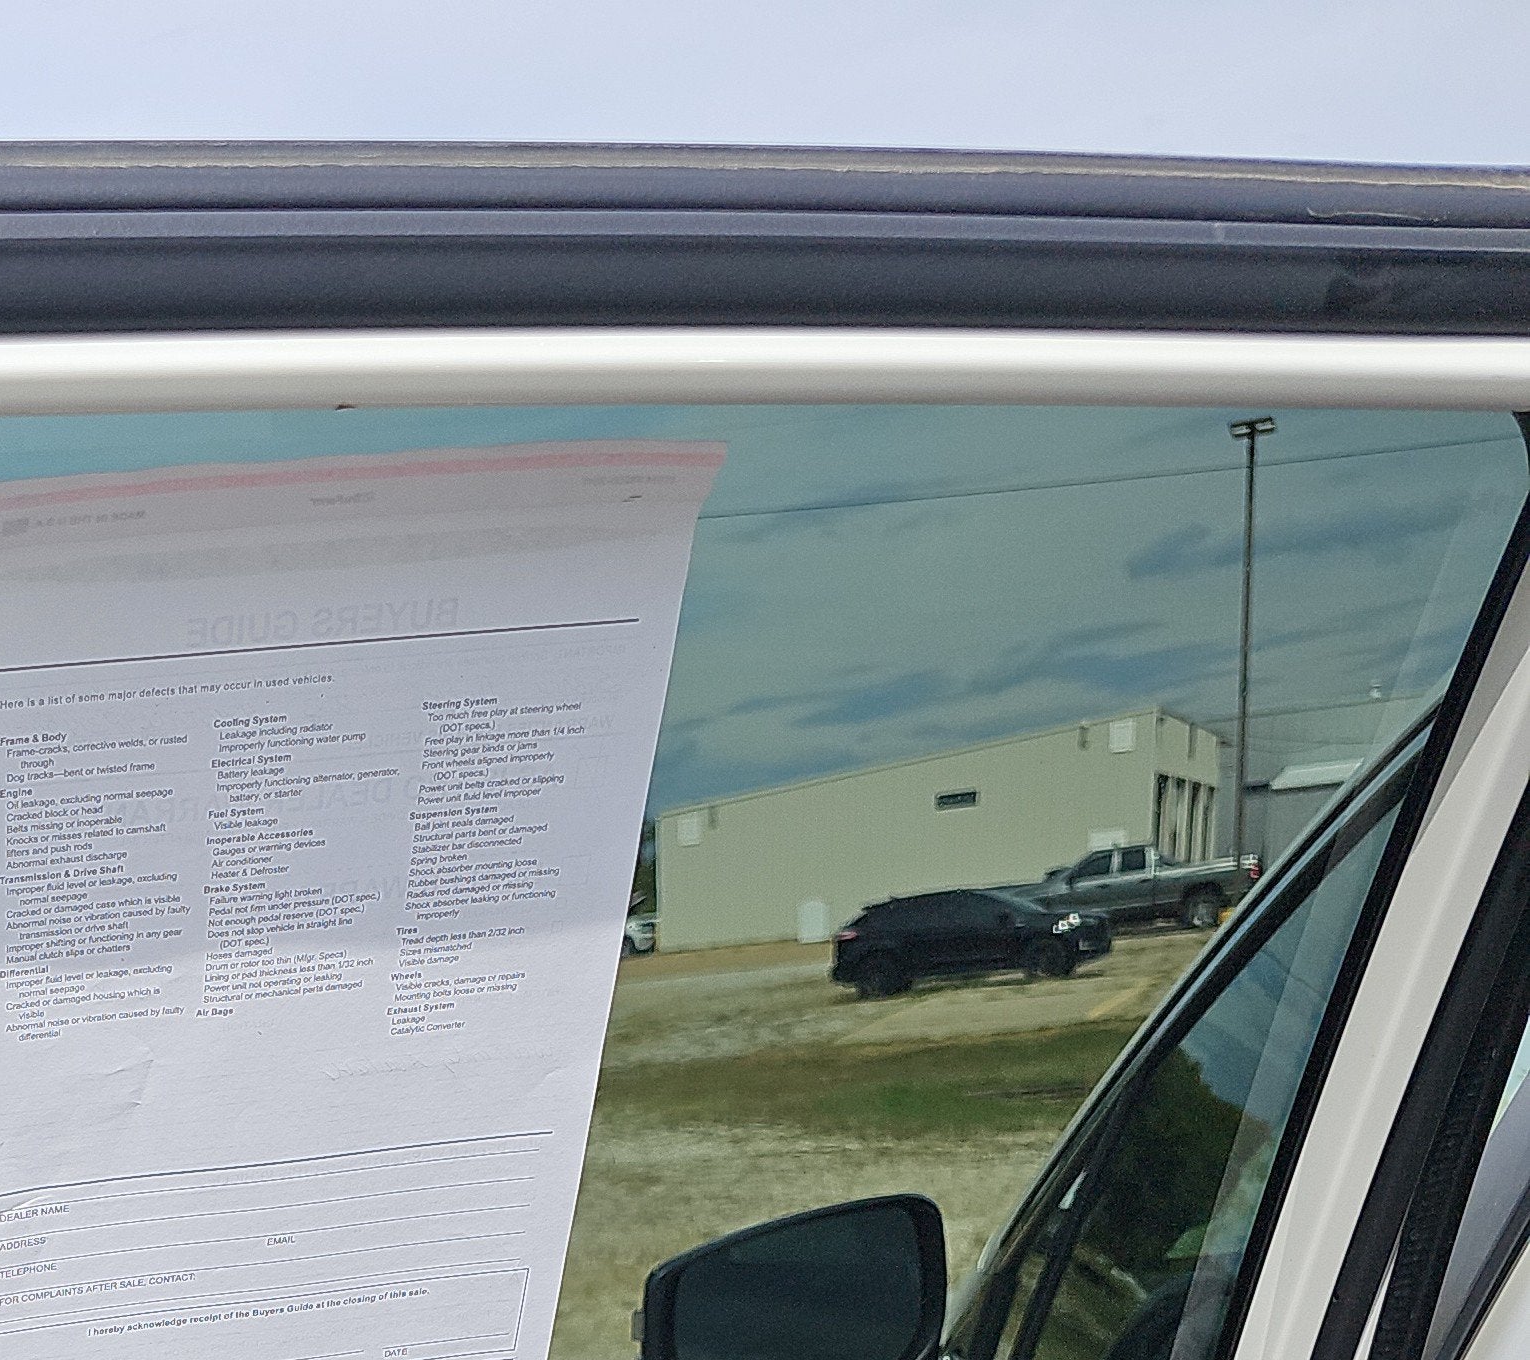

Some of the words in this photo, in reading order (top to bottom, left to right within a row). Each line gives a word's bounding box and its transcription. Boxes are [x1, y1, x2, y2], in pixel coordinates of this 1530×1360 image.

[422, 699, 462, 710] Steering
[462, 696, 498, 708] System
[214, 717, 250, 728] Cooling
[251, 714, 287, 726] System
[0, 736, 30, 746] Frame
[40, 733, 66, 744] Body
[211, 755, 255, 768] Electrical
[256, 753, 292, 765] System
[0, 787, 33, 799] Engine
[208, 808, 228, 819] Fuel
[229, 806, 264, 819] System
[410, 807, 463, 820] Suspension
[463, 804, 498, 816] System
[206, 832, 255, 846] Inoperable
[257, 827, 314, 840] Accessories
[0, 871, 62, 885] Transmission
[72, 867, 97, 878] Drive
[98, 864, 124, 875] Shaft
[396, 926, 418, 935] Tires
[0, 964, 49, 978] Differential
[391, 970, 422, 981] Wheels
[387, 1003, 422, 1015] Exhaust
[422, 1001, 455, 1013] System
[0, 1209, 38, 1223] DEALER
[40, 1205, 69, 1217] NAME
[0, 1236, 46, 1251] ADDRESS
[267, 1235, 296, 1246] EMAIL
[0, 1263, 57, 1279] TELEPHONE
[0, 1295, 19, 1306] FOR
[20, 1287, 83, 1303] COMPLAINTS
[84, 1283, 118, 1295] AFTER
[384, 1347, 408, 1358] DATE
